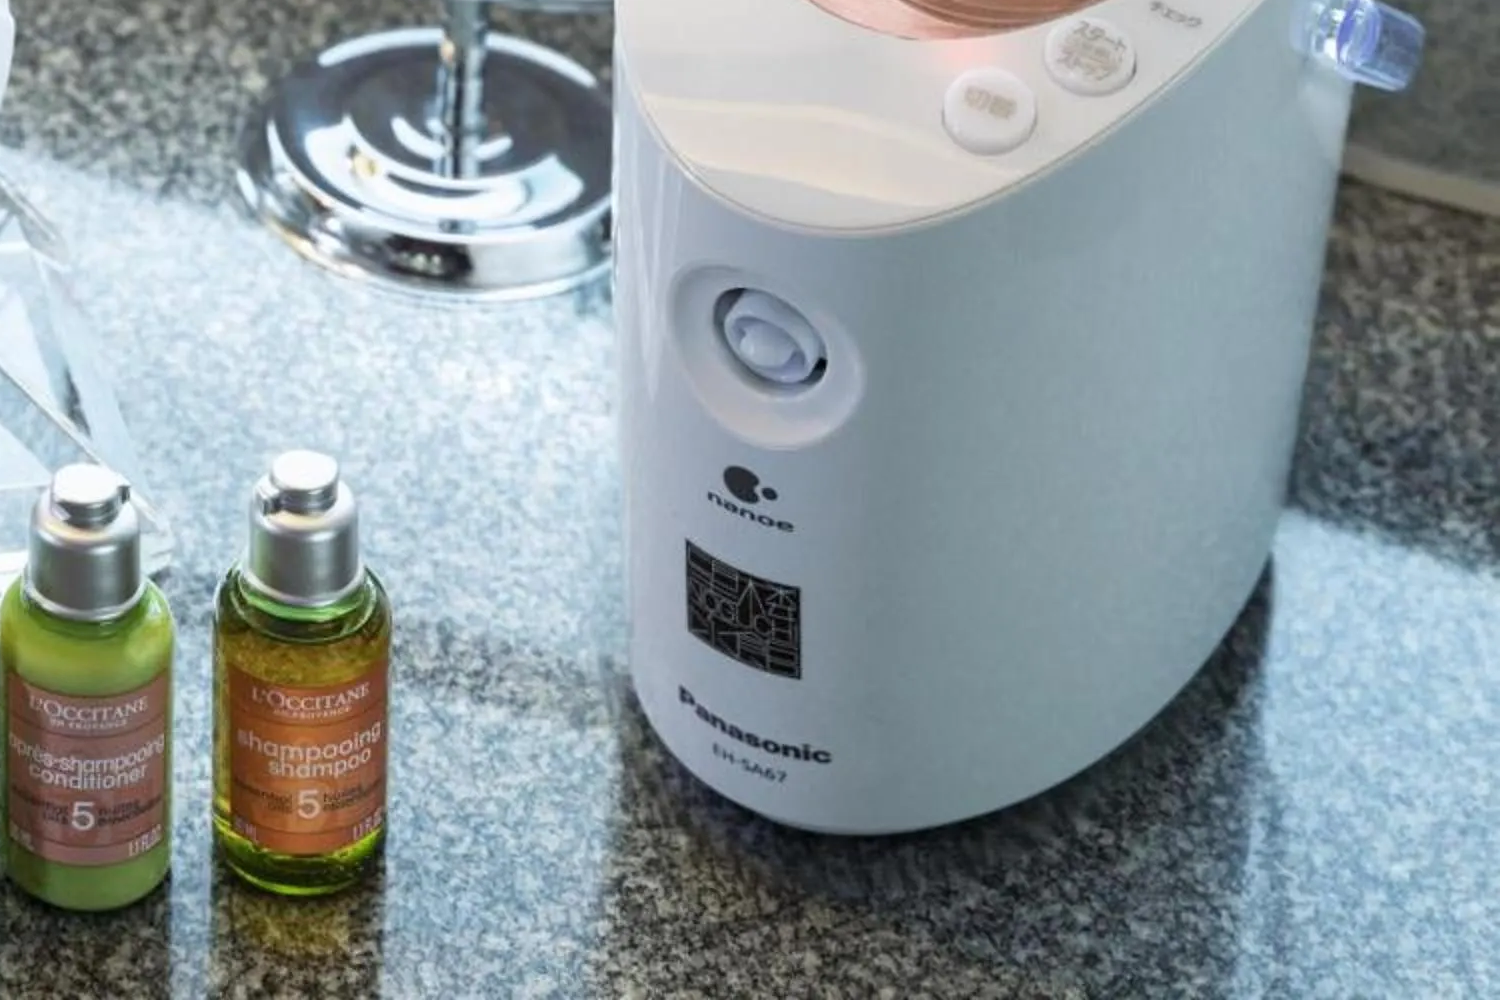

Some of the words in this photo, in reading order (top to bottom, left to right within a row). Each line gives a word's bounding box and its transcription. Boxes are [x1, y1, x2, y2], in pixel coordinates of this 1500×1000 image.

[707, 490, 794, 532] nanoe
[29, 696, 148, 721] L'OCCITANE
[252, 681, 370, 710] L'OCCITANE
[678, 684, 832, 764] Panasonic
[237, 721, 381, 765] shampooing
[29, 764, 148, 791] conditioner
[268, 747, 372, 780] shampoo
[71, 801, 96, 832] 5
[297, 789, 322, 820] 5
